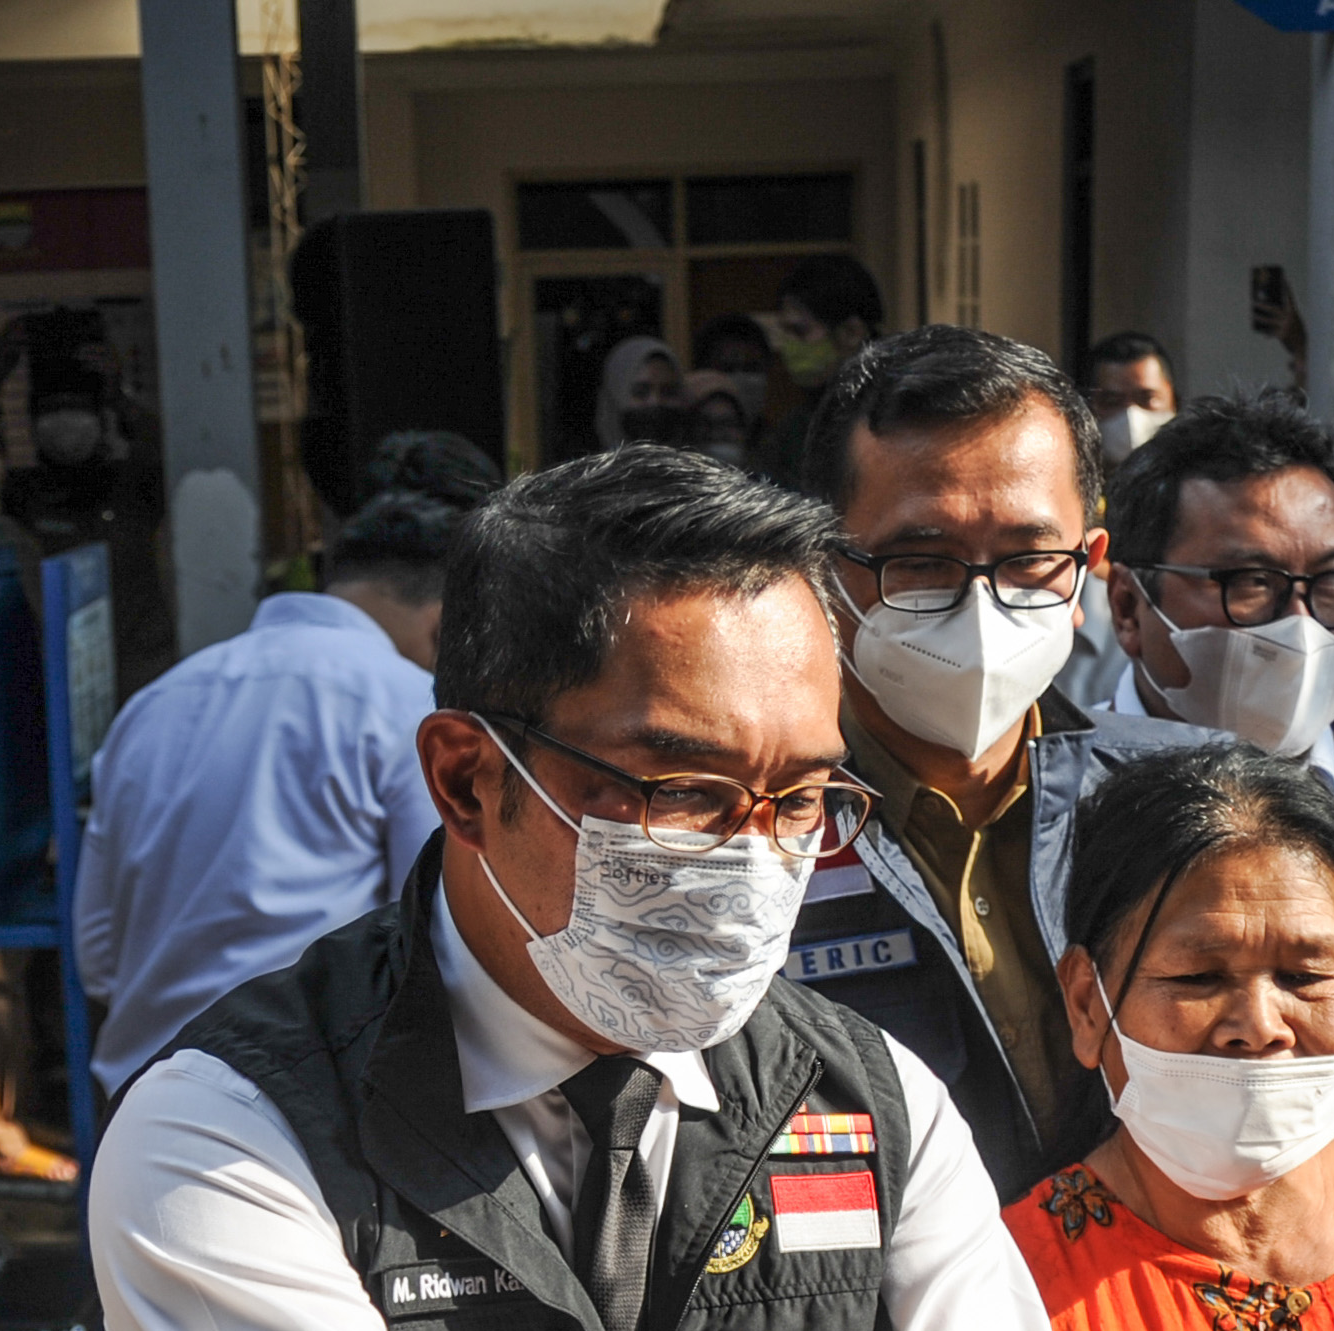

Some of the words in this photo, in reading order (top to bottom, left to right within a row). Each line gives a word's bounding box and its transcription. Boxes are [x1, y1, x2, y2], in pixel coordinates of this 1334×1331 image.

[600, 860, 673, 886] Softies
[799, 939, 893, 976] ERIC
[392, 1276, 416, 1304] M.
[419, 1272, 487, 1301] Ridwan
[493, 1268, 525, 1293] Ka
